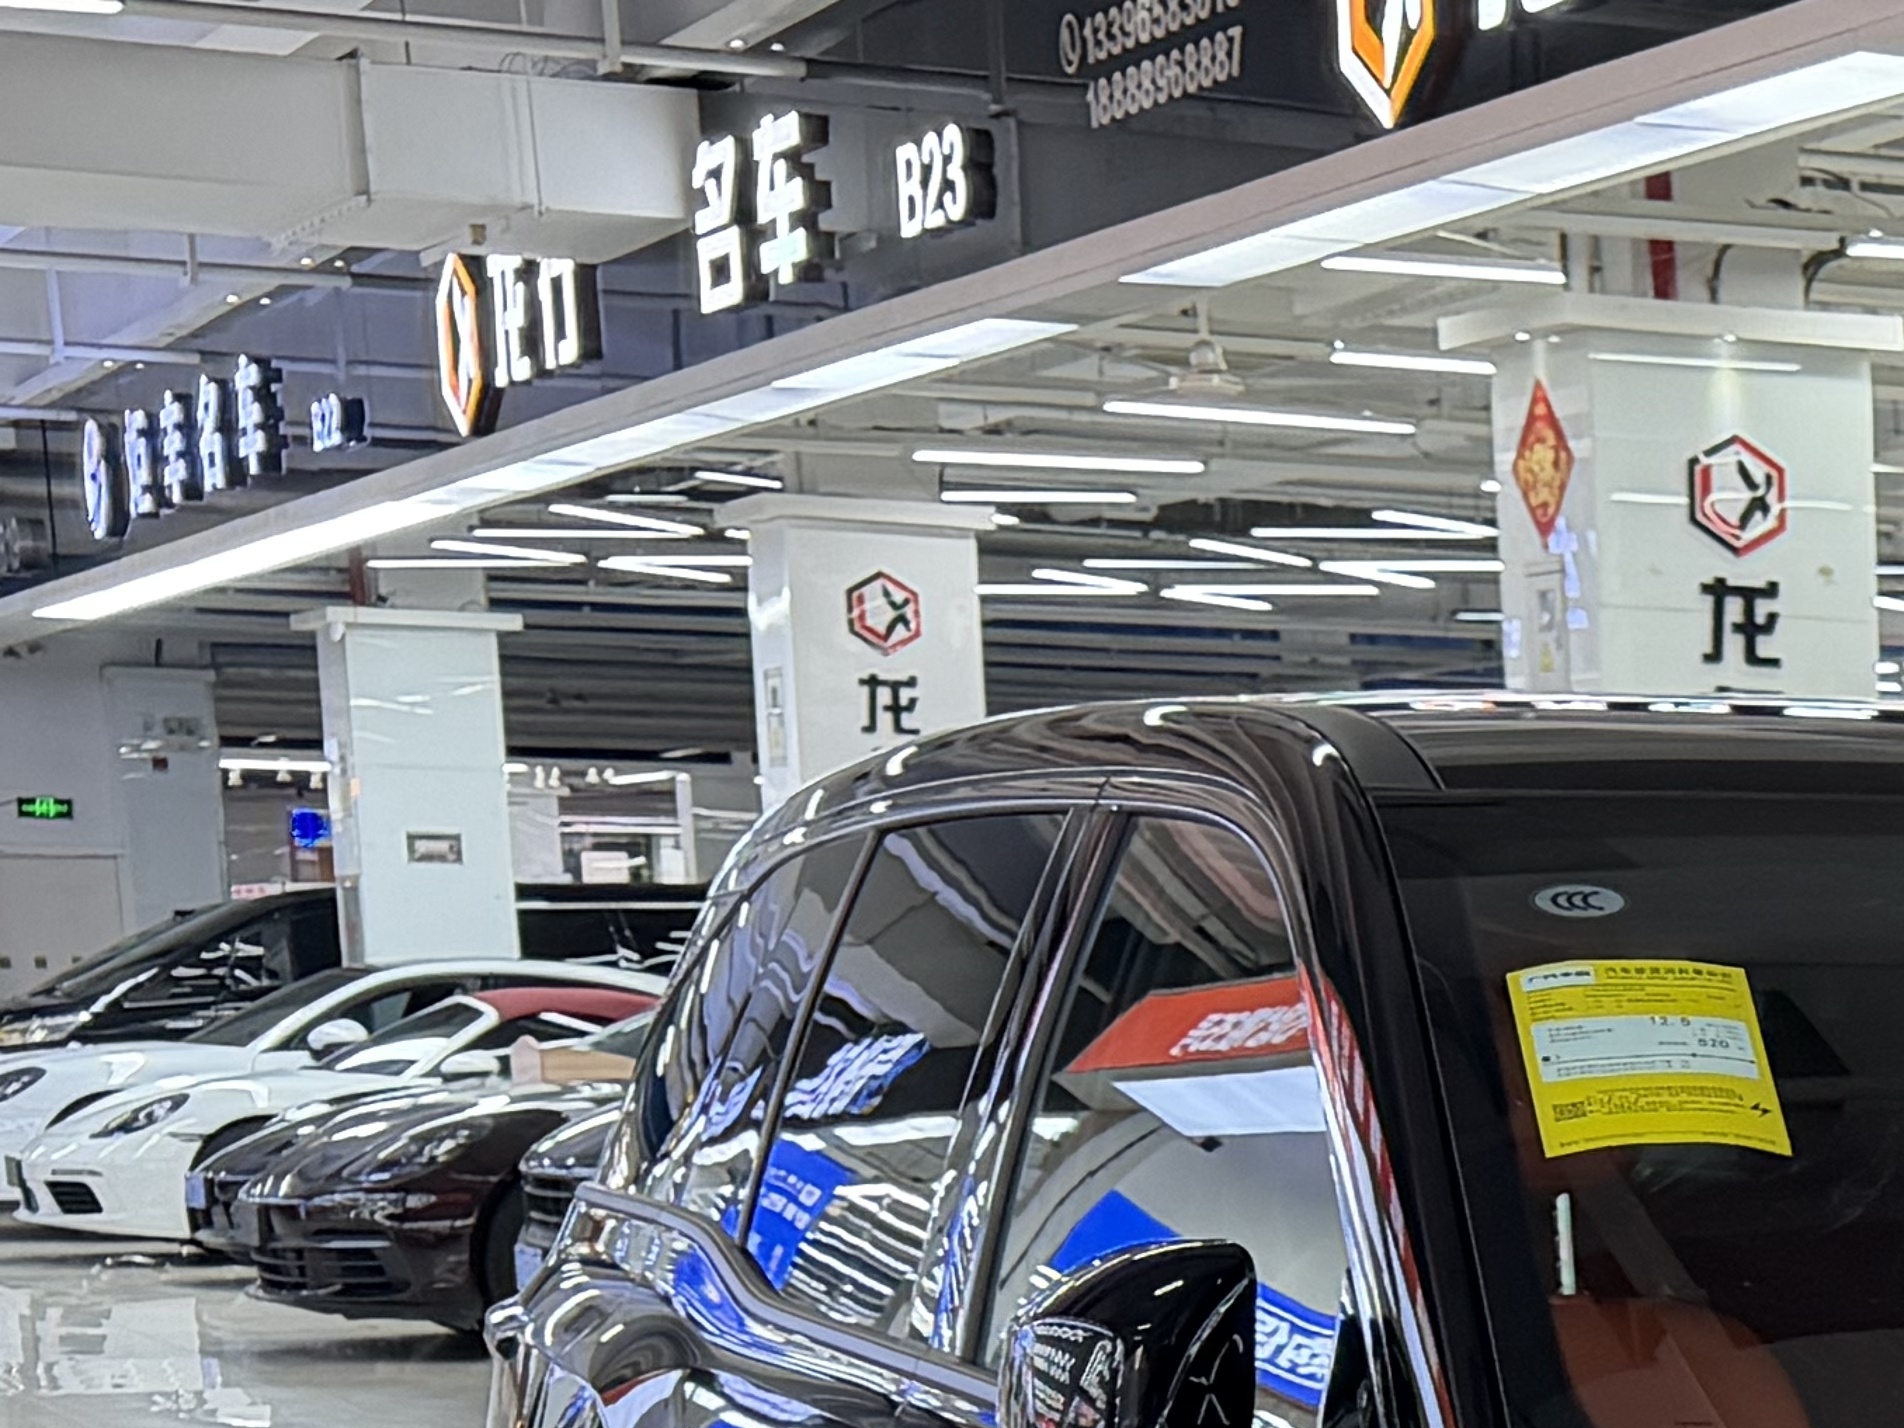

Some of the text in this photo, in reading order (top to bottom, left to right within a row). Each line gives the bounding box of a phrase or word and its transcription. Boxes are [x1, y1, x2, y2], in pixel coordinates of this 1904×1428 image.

[1083, 0, 1239, 65] 13396583
[1085, 25, 1244, 129] 18888968887
[691, 109, 808, 314] 名车
[895, 122, 967, 239] B23
[1700, 576, 1784, 694] 龙
